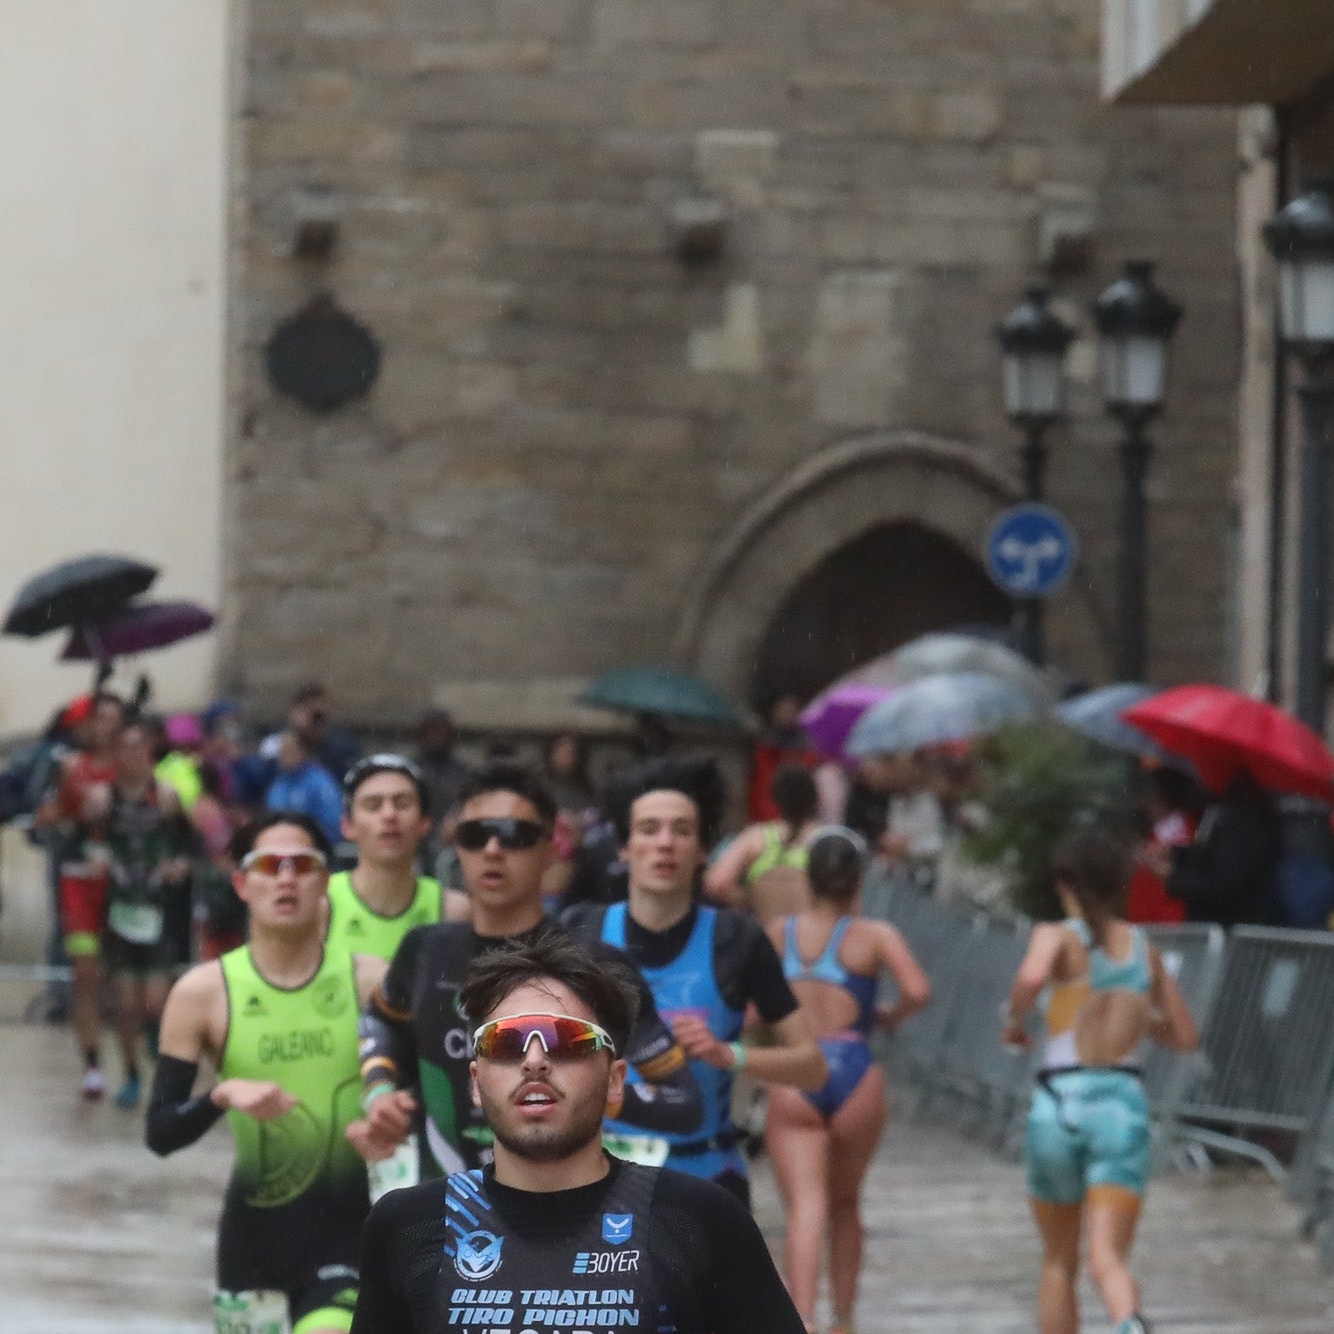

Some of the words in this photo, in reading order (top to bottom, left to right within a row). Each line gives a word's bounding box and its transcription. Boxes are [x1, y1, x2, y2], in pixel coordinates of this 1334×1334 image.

[258, 1028, 335, 1063] GALEANO
[451, 1289, 513, 1305] CLUB
[520, 1289, 634, 1306] TRIATLON
[448, 1307, 514, 1325] TIRO
[522, 1308, 640, 1327] PICHON
